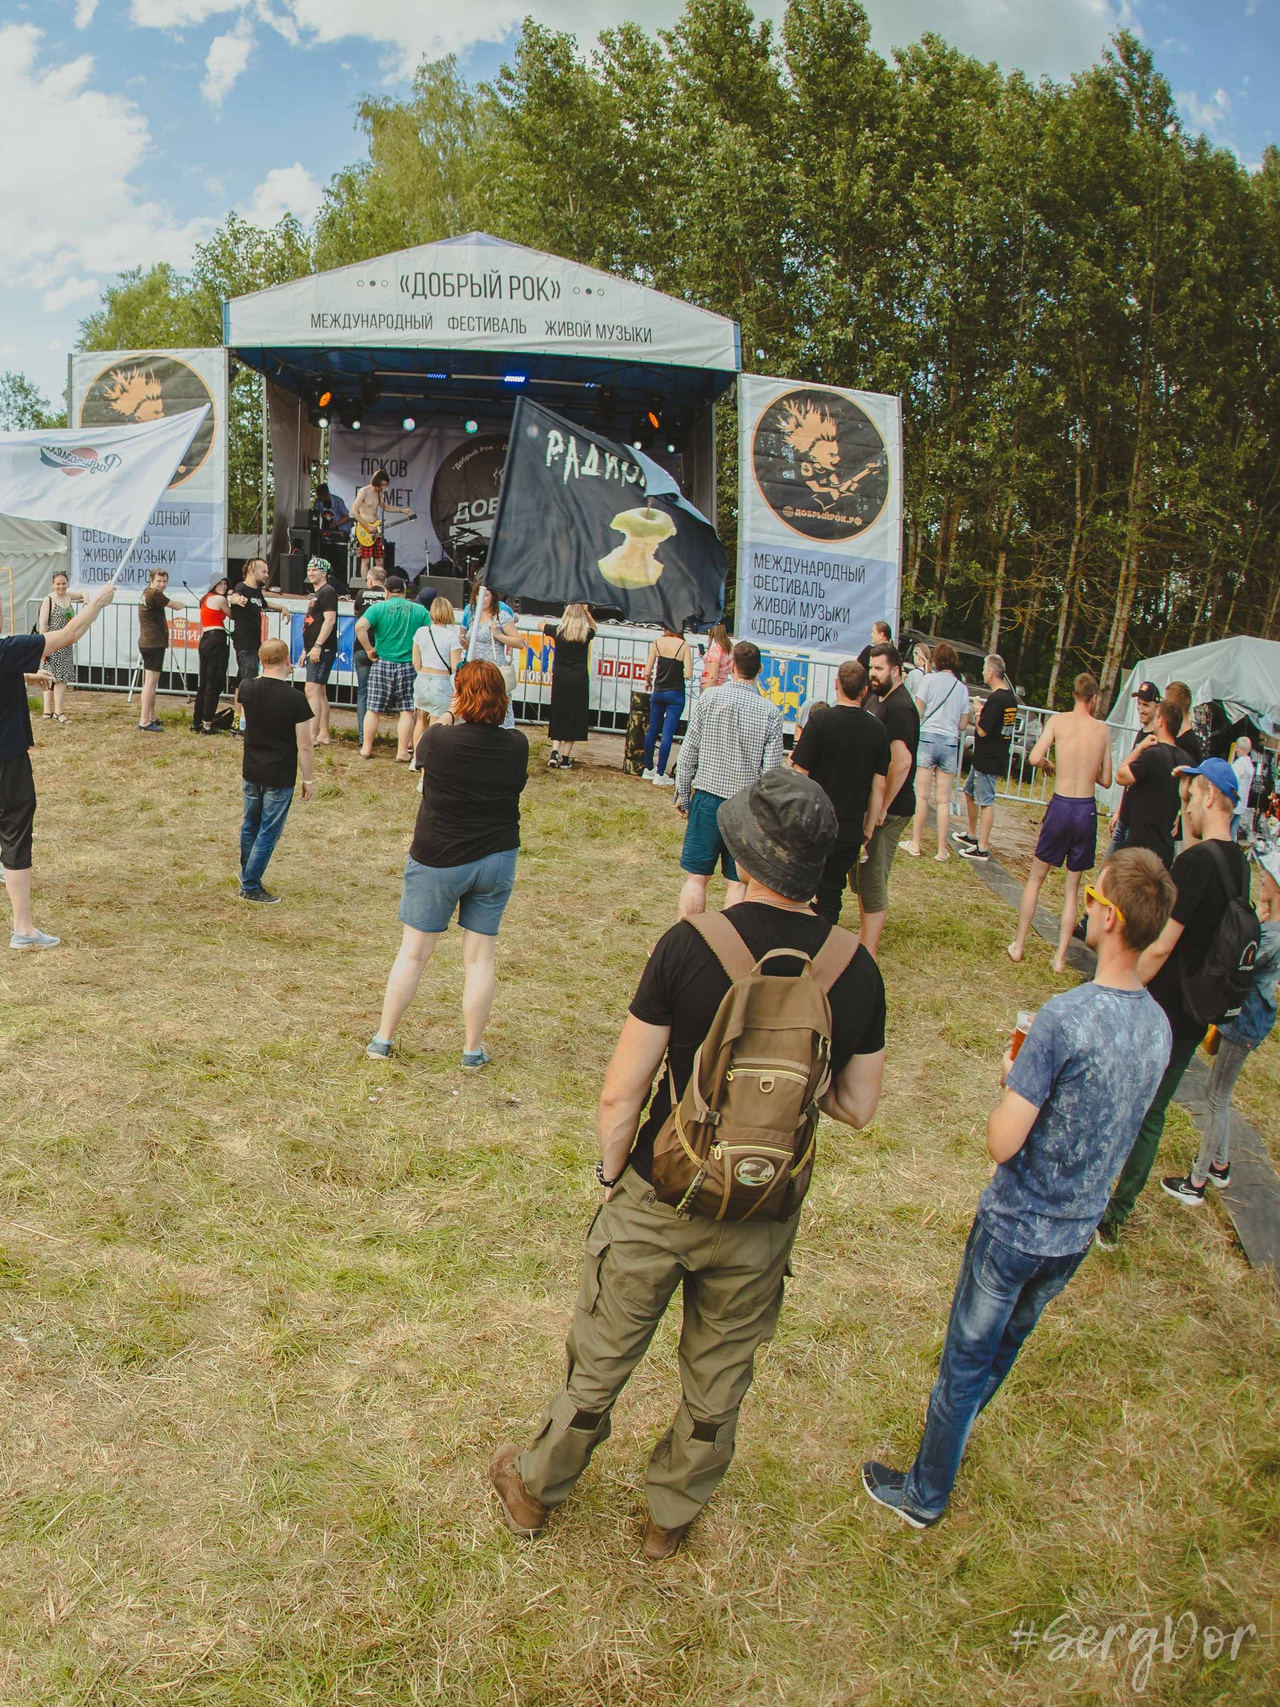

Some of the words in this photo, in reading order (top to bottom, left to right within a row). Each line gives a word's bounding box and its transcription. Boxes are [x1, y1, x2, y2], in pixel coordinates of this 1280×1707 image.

[399, 270, 503, 300] «ДОБРЫЙ
[509, 276, 562, 301] РОК»
[310, 312, 433, 331] МЕЖДУНАРОДНЫЙ
[447, 315, 527, 334] ФЕСТИВАЛЬ
[544, 319, 592, 338] ЖИВОЙ
[595, 325, 653, 344] МУЗЫКИ
[361, 457, 408, 478] ПСКОВ
[82, 545, 122, 562] ЖИВОЙ
[753, 552, 866, 584] МЕЖДУНАРОДНЫЙ
[753, 574, 825, 599] ФЕСТИВАЛЬ
[752, 595, 797, 617] ЖИВОЙ
[799, 602, 851, 624] МУЗЫКИ
[751, 617, 808, 640] «ДОБРЫЙ
[810, 625, 839, 643] РОК»
